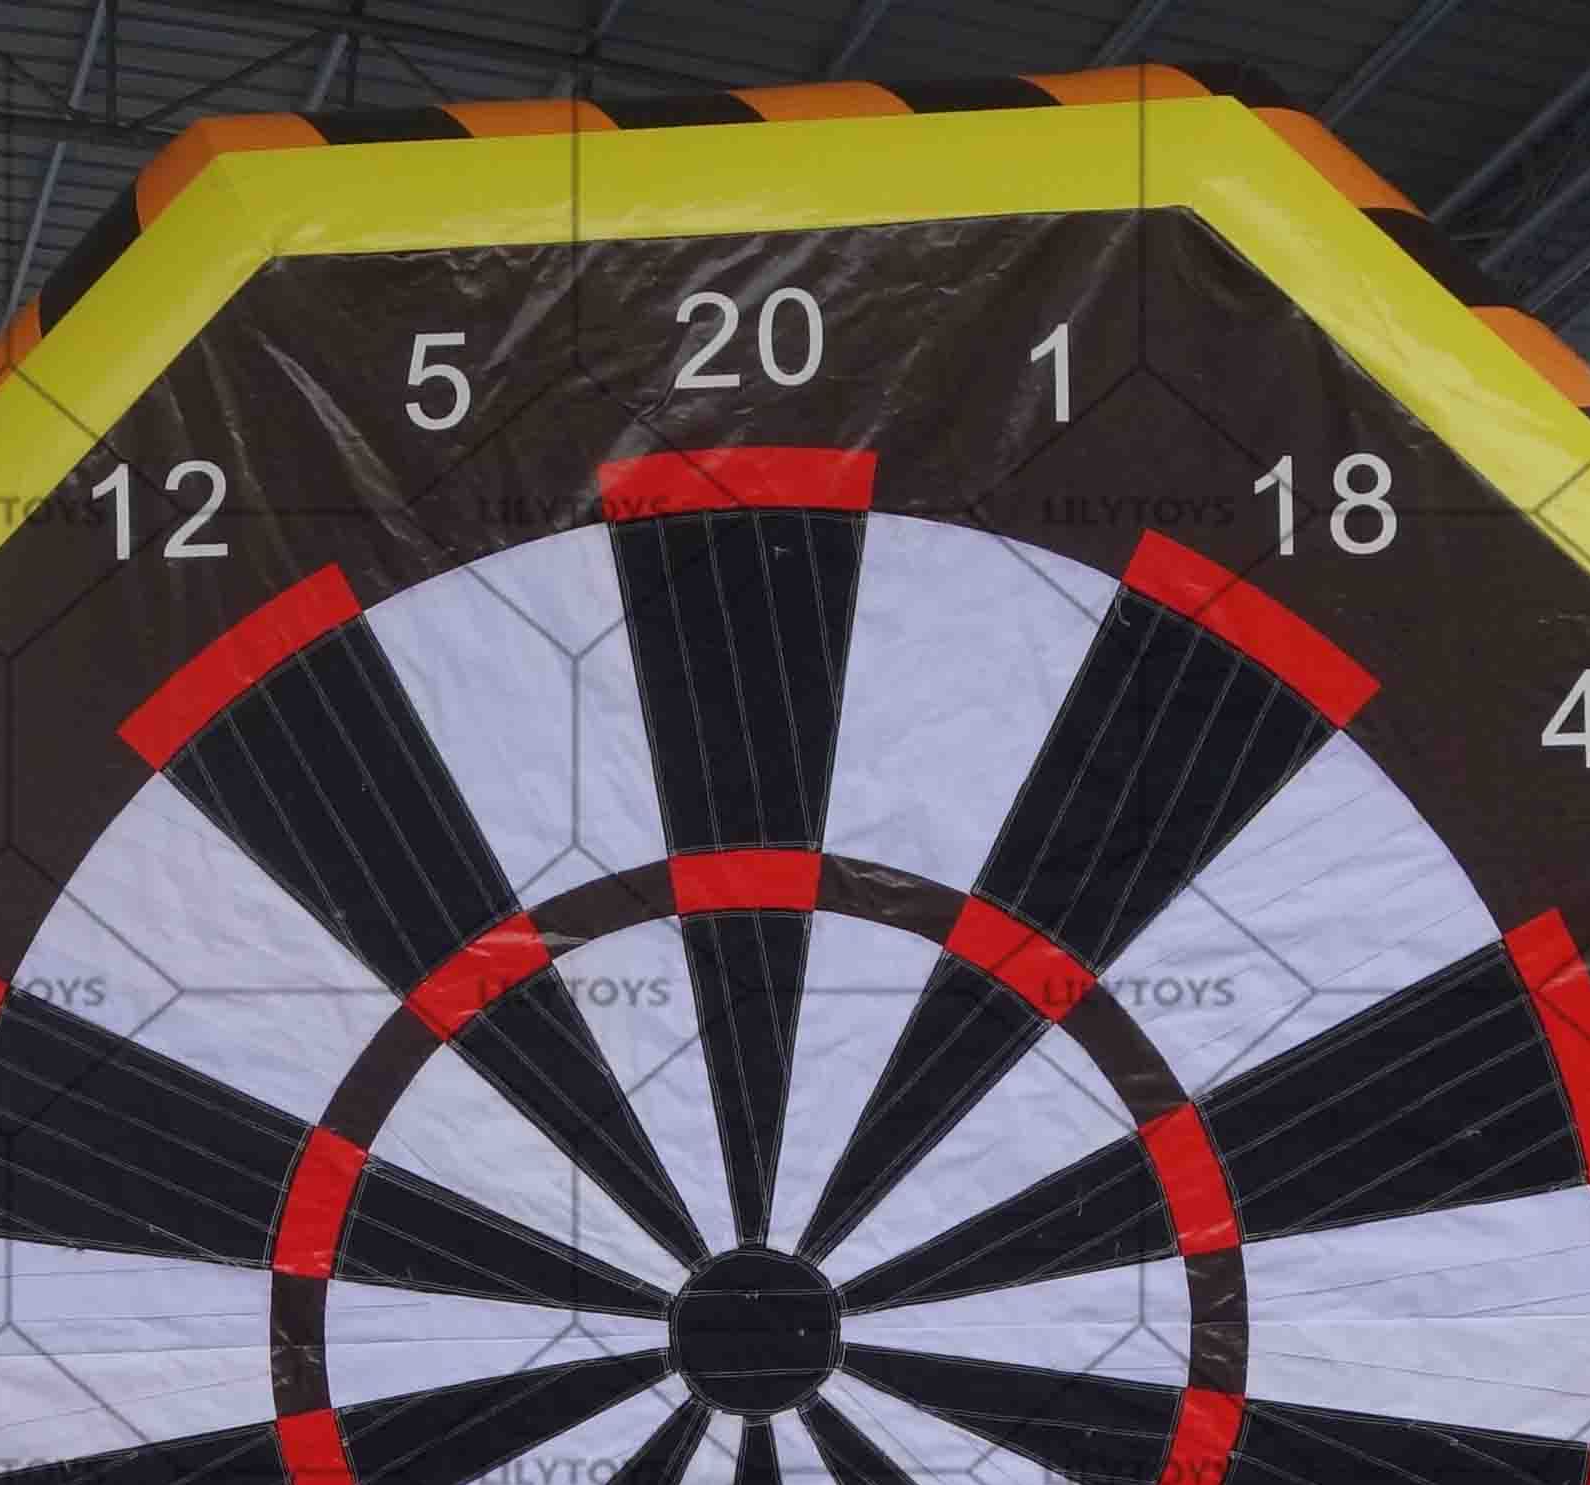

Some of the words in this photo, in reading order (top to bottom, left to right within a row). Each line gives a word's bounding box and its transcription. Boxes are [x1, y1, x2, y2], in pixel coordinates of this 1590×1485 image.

[404, 331, 472, 432] 5
[672, 286, 825, 390] 20
[1029, 321, 1071, 424] 1
[91, 459, 230, 561] 12
[1253, 452, 1398, 557] 18
